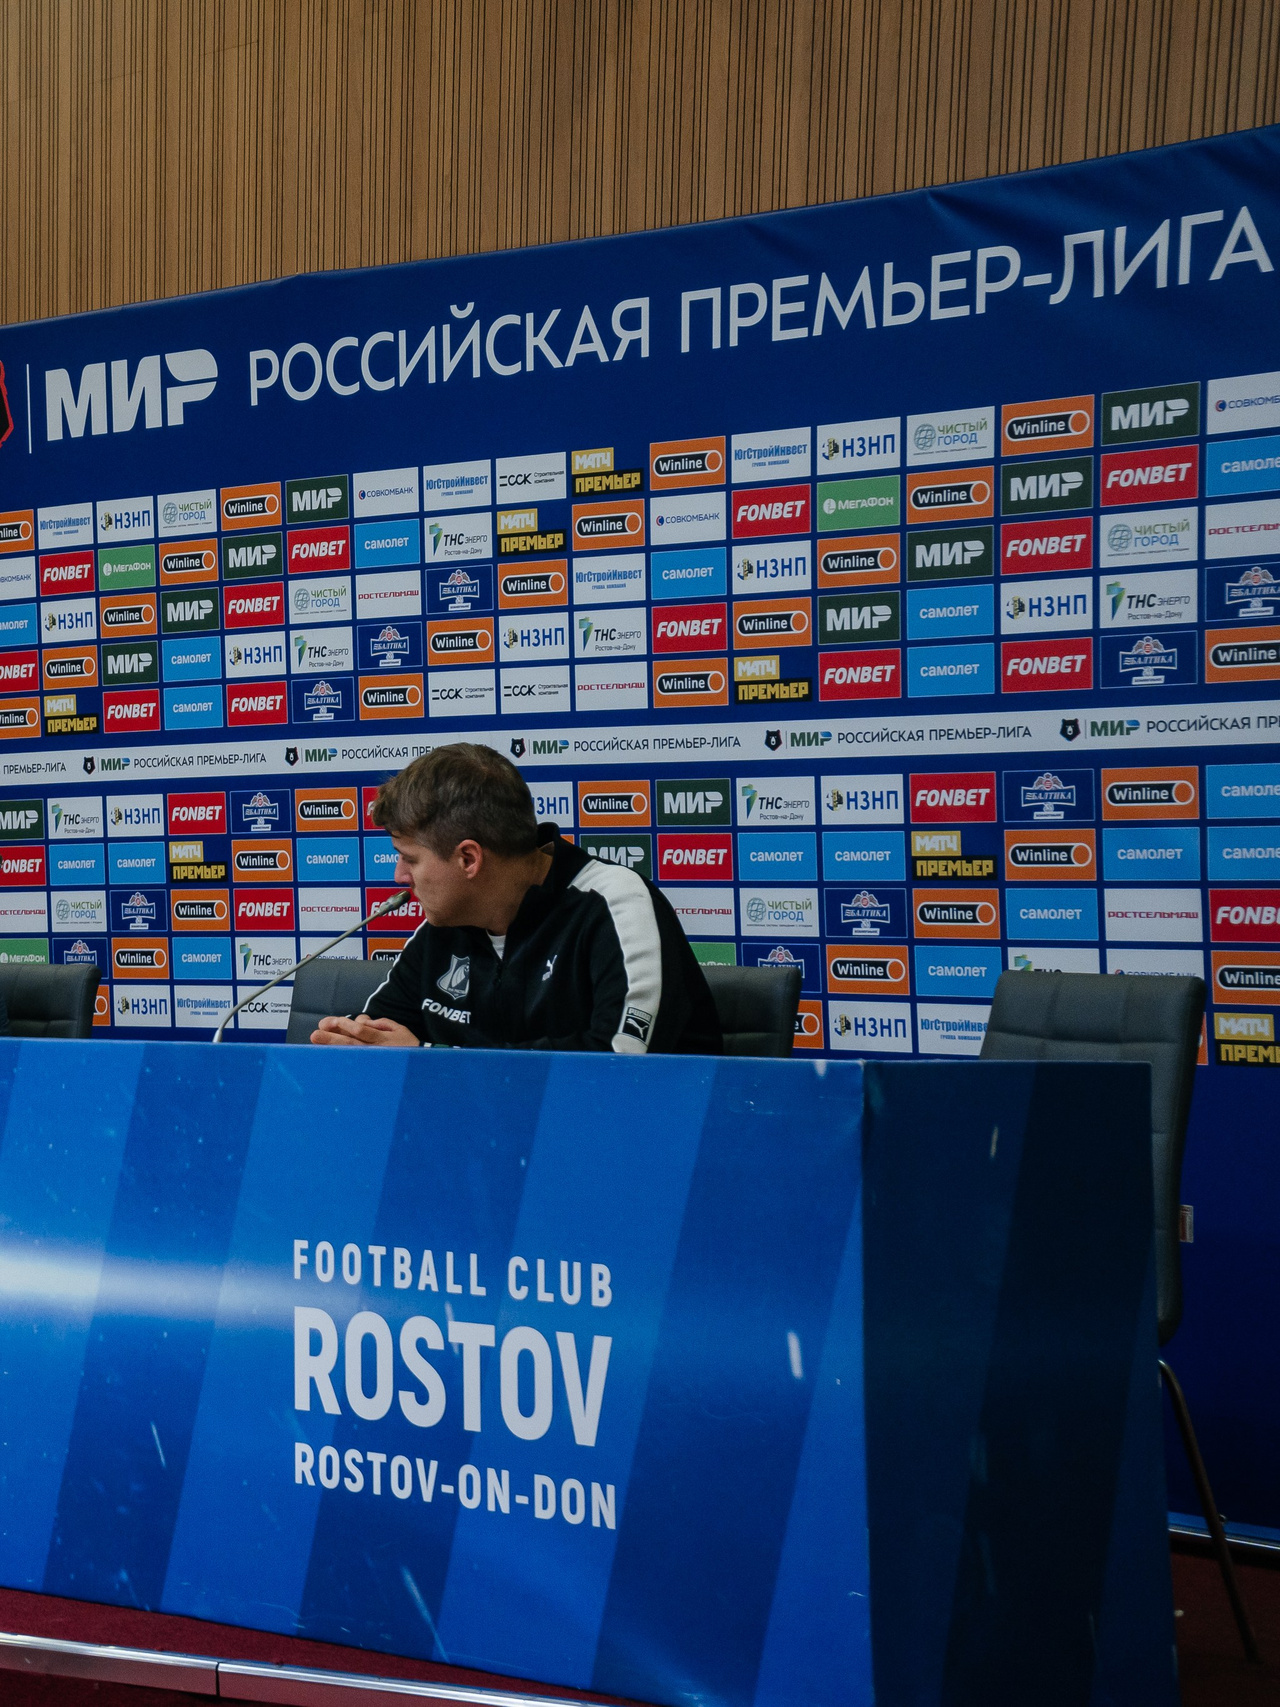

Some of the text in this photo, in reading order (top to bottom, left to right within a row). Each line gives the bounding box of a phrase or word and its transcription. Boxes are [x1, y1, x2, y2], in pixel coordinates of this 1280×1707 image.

[46, 206, 1274, 442] МИР РОССИЙСКАЯ ПРЕМЬЕР-ЛИГА
[1229, 395, 1280, 408] СОВКОМБ
[937, 418, 987, 434] ЧИСТЫЙ
[1013, 419, 1065, 436] Winline
[938, 433, 978, 446] ГОРОД
[734, 444, 807, 461] ЮгСтройИнвест
[1106, 463, 1191, 488] FONBET
[367, 487, 413, 498] СОВКОМБАНК
[1010, 471, 1083, 501] МИР
[178, 499, 212, 511] ЧИСТЫЙ
[229, 501, 263, 514] Winline
[292, 488, 342, 512] МИР
[178, 511, 206, 520] ГОРОД
[666, 512, 720, 524] СОВКОМБАНК
[736, 500, 805, 522] FONBET
[40, 517, 90, 530] ЮгСтройИнвест
[115, 510, 150, 529] НЗНП
[500, 512, 535, 529] МАТЧ
[581, 518, 622, 533] Winline
[1135, 519, 1190, 535] ЧИСТЫЙ
[364, 536, 409, 548] самолет
[444, 533, 464, 546] ТНС
[501, 533, 563, 552] ПРЕМЬЕР
[1006, 534, 1086, 557] FONBET
[1135, 534, 1179, 547] ГОРОД
[229, 545, 276, 568] МИР
[828, 555, 875, 569] Winline
[43, 564, 91, 582] FONBET
[662, 566, 713, 580] самолет
[756, 556, 806, 579] НЗНП
[1029, 594, 1086, 618] НЗНП
[1127, 594, 1156, 609] ТНС
[167, 600, 213, 622] МИР
[826, 605, 892, 631] МИР
[919, 604, 979, 620] самолет
[58, 612, 92, 629] НЗНП
[435, 635, 473, 649] Winline
[520, 627, 564, 647] НЗНП
[594, 628, 616, 641] ТНС
[244, 646, 282, 664] НЗНП
[308, 646, 327, 658] ТНС
[1218, 648, 1277, 662] Winline
[108, 653, 152, 674] МИР
[738, 660, 776, 677] МАТЧ
[920, 662, 980, 677] самолет
[824, 665, 895, 685] FONBET
[231, 695, 283, 712] FONBET
[366, 691, 404, 704] Winline
[108, 703, 156, 719] FONBET
[48, 717, 97, 733] ПРЕМЬЕР
[1091, 719, 1140, 737] МИР
[1147, 714, 1251, 732] РОССИЙСКАЯ
[791, 726, 1032, 747] МИР РОССИЙСКАЯ ПРЕМЬЕР-ЛИГА
[533, 735, 741, 754] МИР РОССИЙСКАЯ ПРЕМЬЕР-ЛИГА
[305, 748, 337, 763] МИР
[342, 745, 408, 759] РОССИЙСКАЯ
[4, 762, 66, 775] ПРЕМЬЕР-ЛИГА
[101, 753, 266, 771] МИР РОССИЙСКАЯ ПРЕМЬЕР-ЛИГА
[915, 788, 990, 807] FONBET
[1222, 785, 1280, 797] самоле
[532, 797, 568, 814] ЗНП
[587, 799, 628, 810] Winline
[759, 796, 782, 809] ТНС
[846, 791, 898, 810] НЗНП
[64, 814, 80, 824] ТНС
[125, 807, 160, 824] НЗНП
[172, 806, 222, 821] FONBET
[173, 844, 201, 859] МАТЧ
[307, 854, 349, 864] самолет
[835, 849, 890, 861] самолет
[1, 859, 42, 873] ONBET
[117, 857, 156, 869] самолет
[240, 856, 274, 866] Winline
[917, 859, 993, 877] ПРЕМЬЕР
[173, 865, 225, 879] ПРЕМЬЕР
[71, 899, 102, 910] ЧИСТЫЙ
[238, 902, 290, 916] FONBET
[371, 902, 422, 916] FNBET
[768, 898, 812, 910] ЧИСТЫЙ
[71, 910, 96, 919] ГОРОД
[768, 911, 804, 922] ГОРОД
[924, 908, 973, 921] Winline
[1020, 908, 1082, 920] самолет
[253, 955, 271, 965] ТНС
[838, 963, 884, 976] Winline
[928, 965, 987, 978] самолет
[177, 998, 231, 1009] ЮгСтройИнвест
[421, 999, 471, 1024] FONBET
[854, 1017, 907, 1038] НЗНП
[1219, 1018, 1269, 1035] МАТЧ
[294, 1239, 612, 1307] FOOTBALL CLUB
[294, 1306, 613, 1447] ROSTOV
[295, 1442, 616, 1530] ROSTOV-ON-DON
